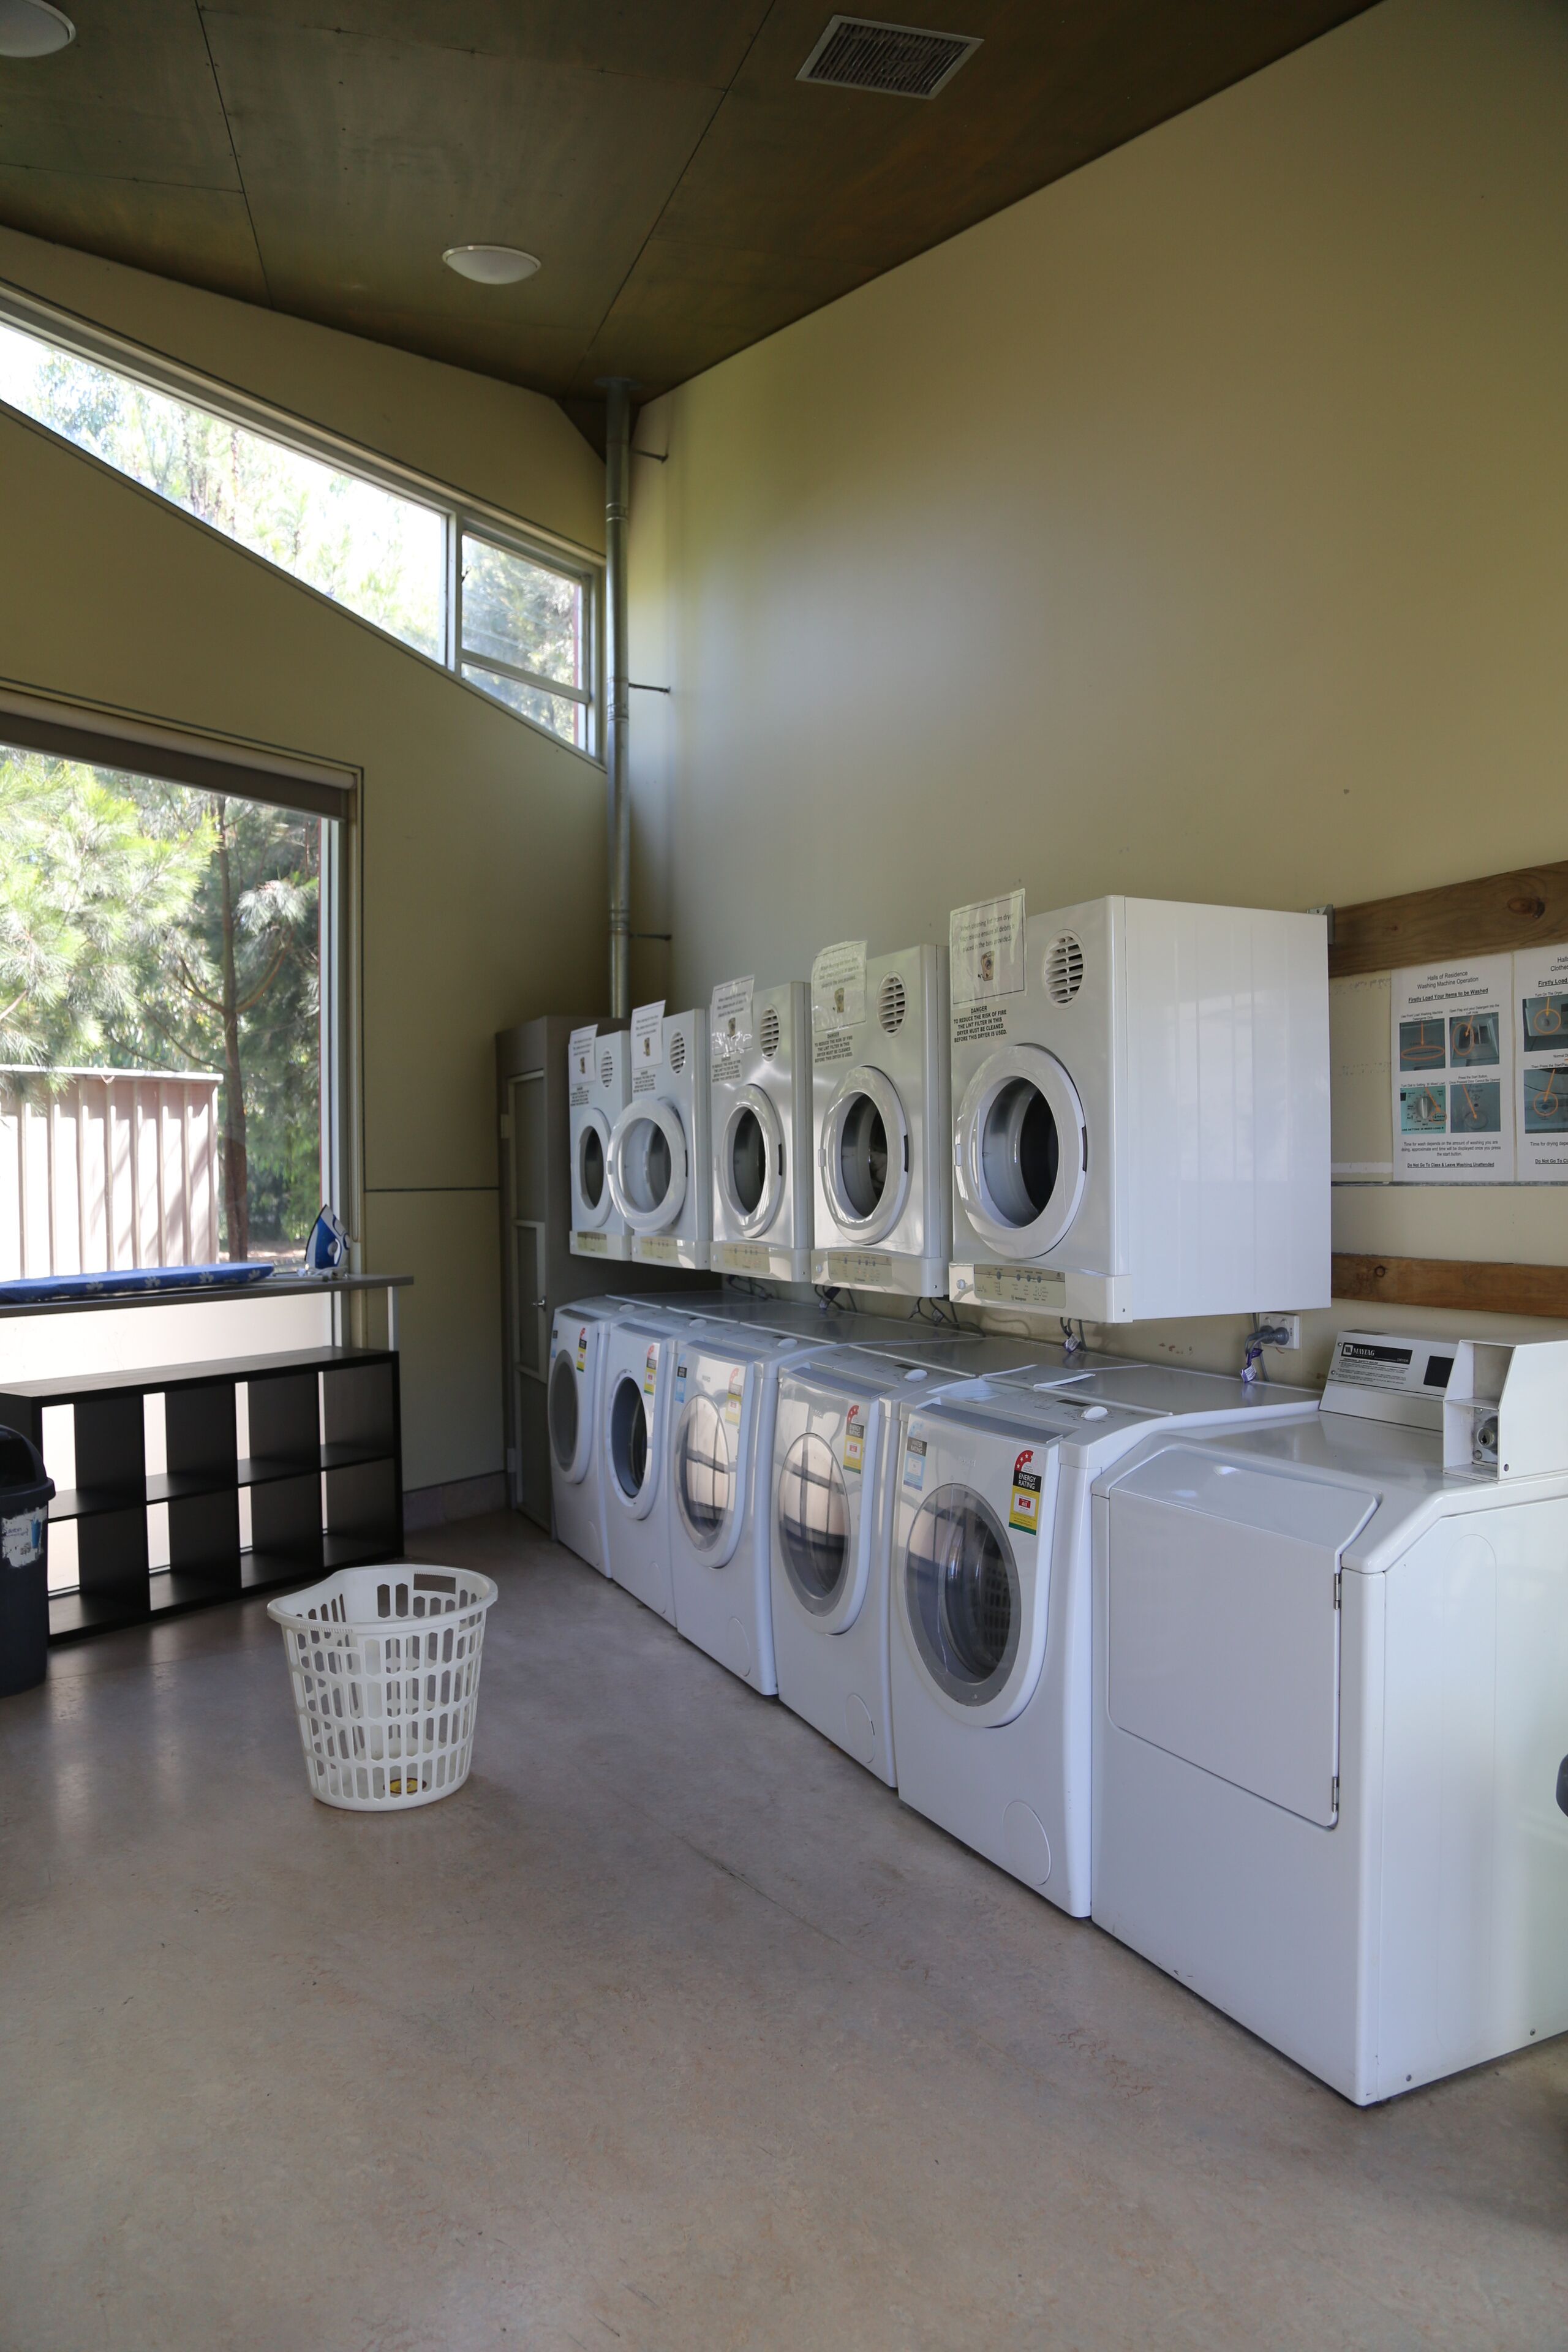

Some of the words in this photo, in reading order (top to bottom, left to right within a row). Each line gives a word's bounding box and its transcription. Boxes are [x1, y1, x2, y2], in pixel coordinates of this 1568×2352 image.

[1354, 1348, 1375, 1356] MAYTAG
[1019, 1473, 1036, 1483] ENERGY
[1018, 1479, 1035, 1490] RATING
